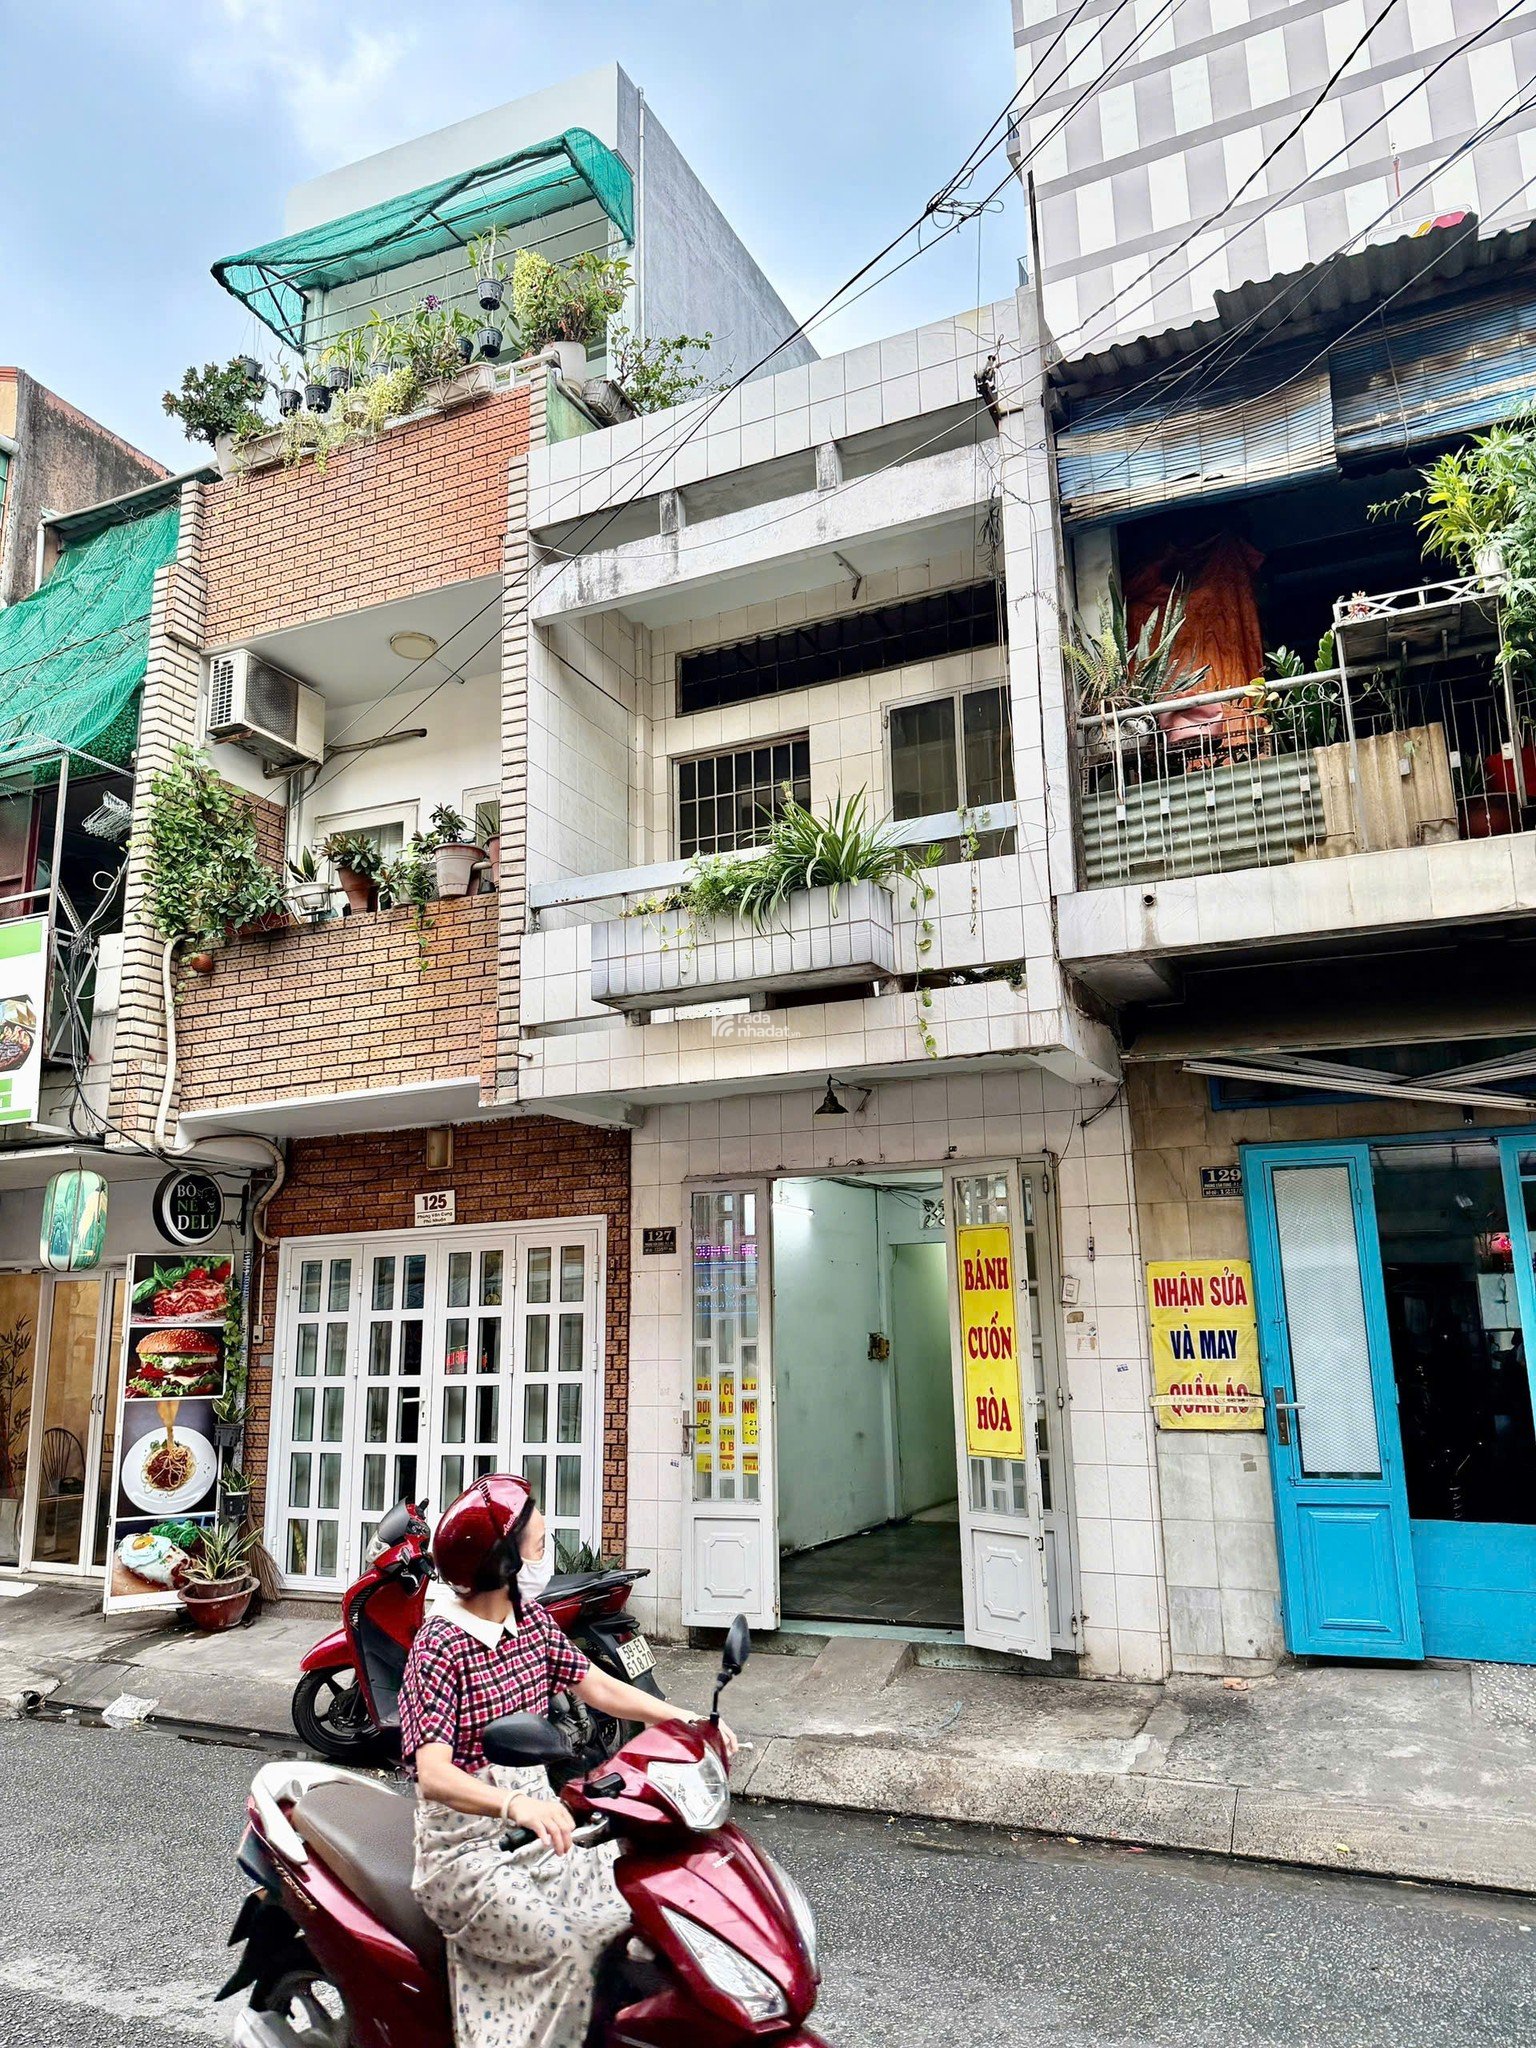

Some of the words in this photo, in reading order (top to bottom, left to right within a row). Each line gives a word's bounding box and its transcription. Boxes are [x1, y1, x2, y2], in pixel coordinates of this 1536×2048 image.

[177, 1182, 197, 1197] BÒ
[1207, 1168, 1242, 1182] 129
[422, 1193, 447, 1210] 125
[177, 1214, 215, 1230] DELI
[647, 1230, 672, 1242] 127
[963, 1249, 1010, 1290] BÁNH
[1153, 1271, 1205, 1313] NHẬN
[1209, 1266, 1249, 1307] SỬA
[967, 1311, 1013, 1360] CUỐN
[1169, 1323, 1196, 1360] VÀ
[1199, 1329, 1238, 1360] MAY
[976, 1387, 1013, 1431] HÒA
[1170, 1374, 1220, 1417] QUẦN
